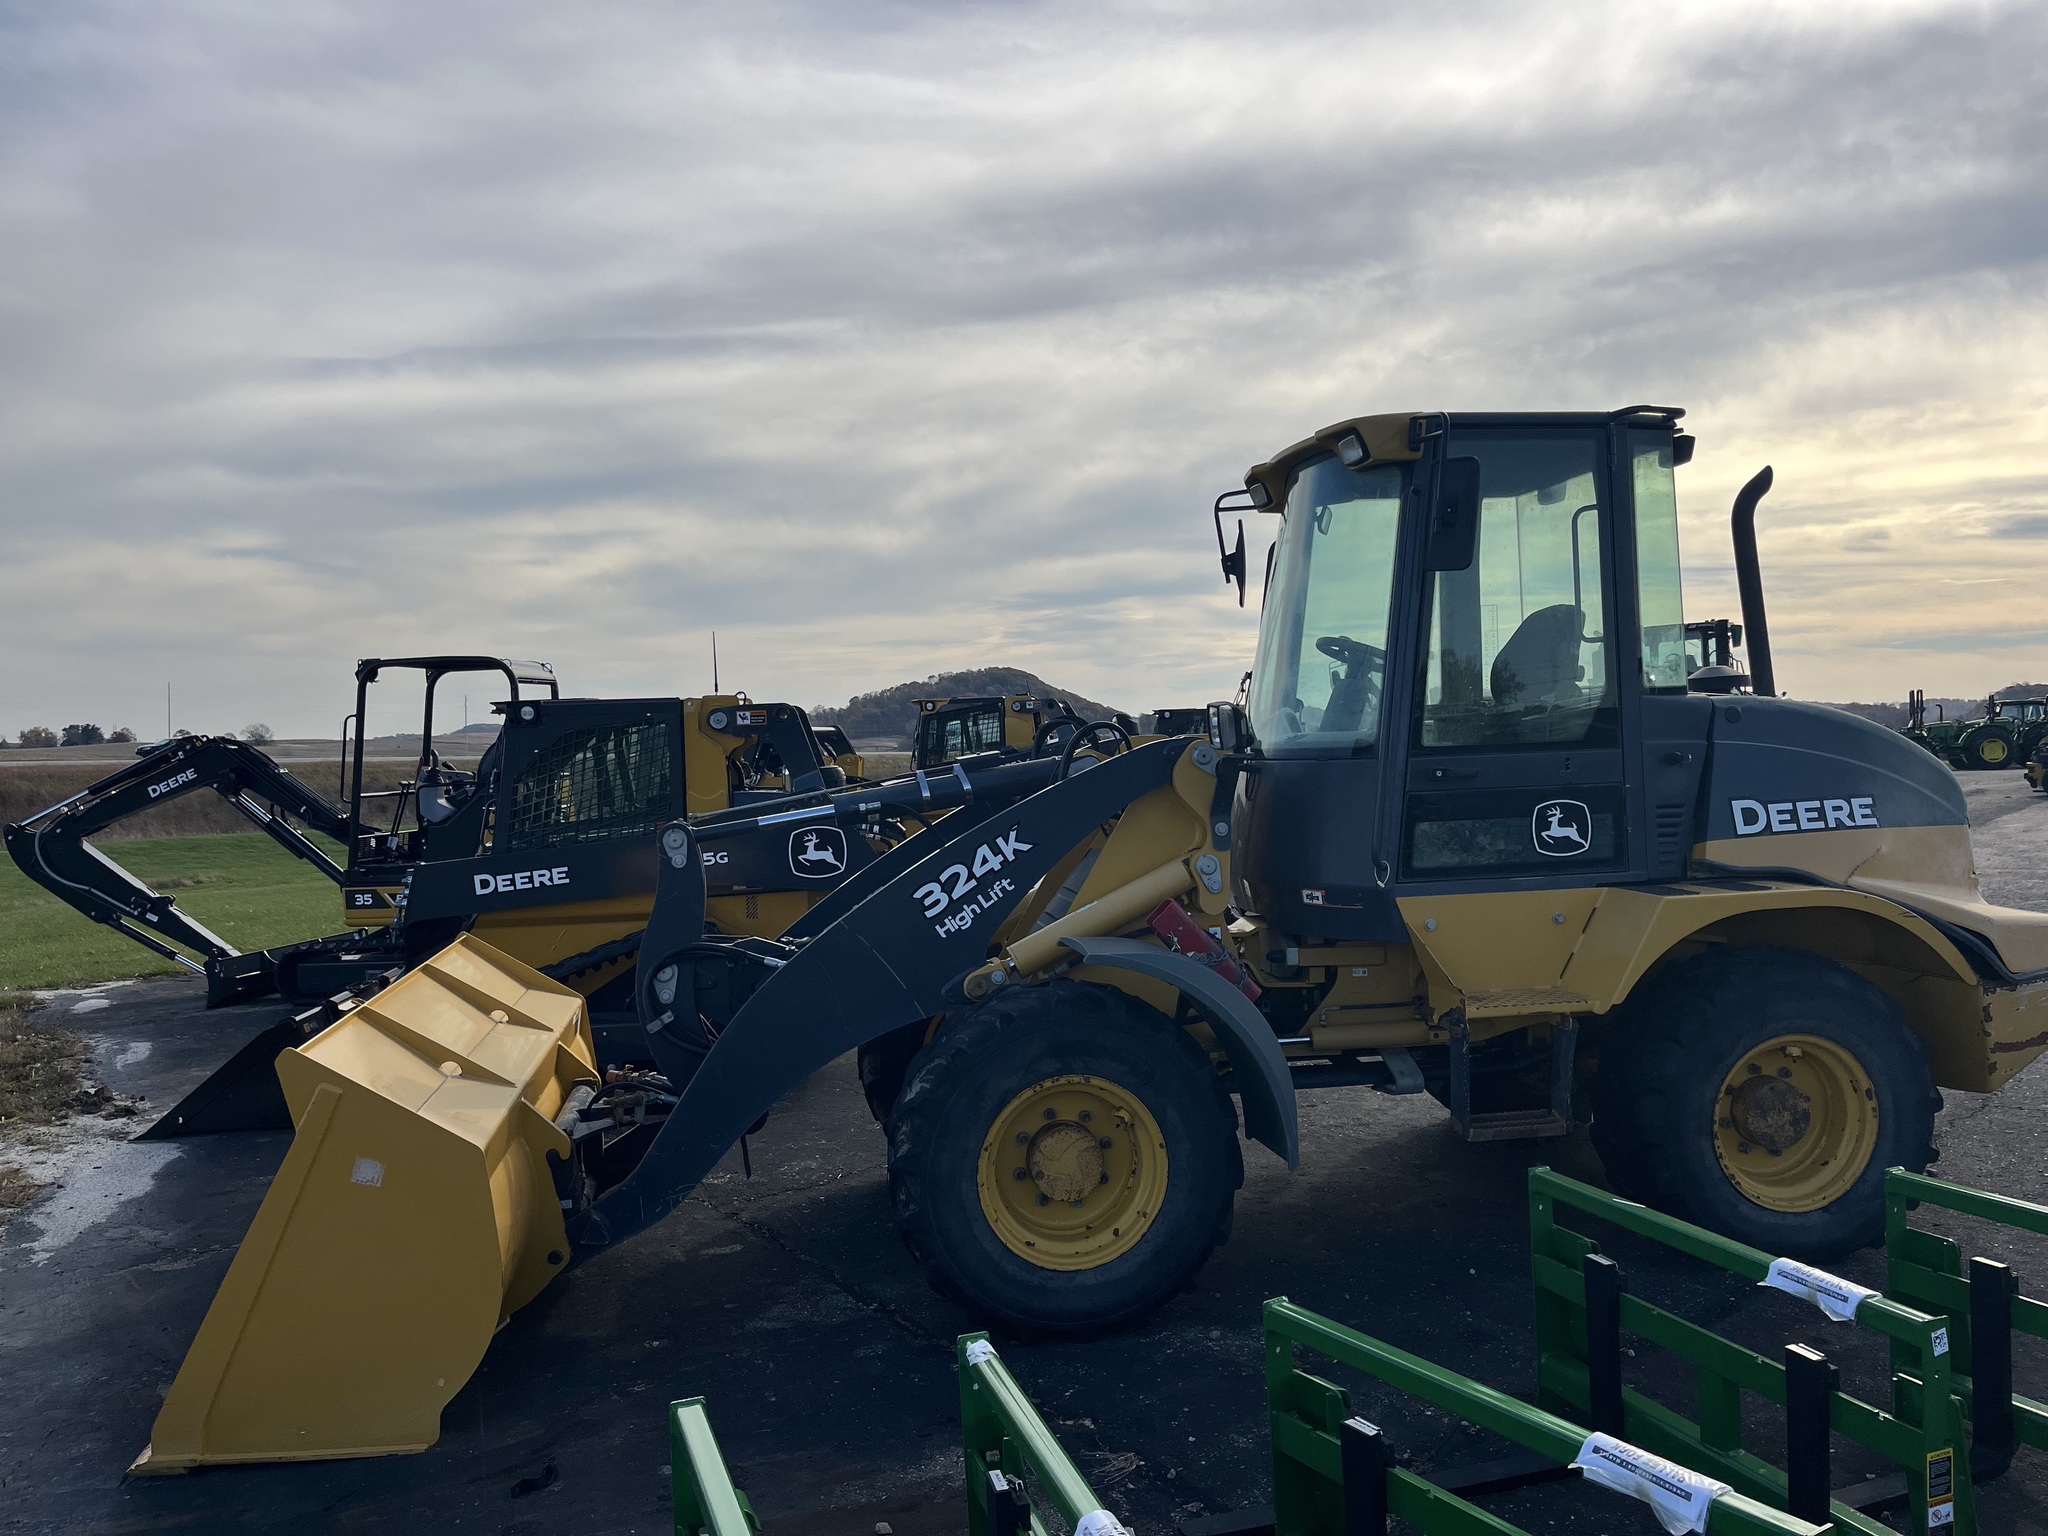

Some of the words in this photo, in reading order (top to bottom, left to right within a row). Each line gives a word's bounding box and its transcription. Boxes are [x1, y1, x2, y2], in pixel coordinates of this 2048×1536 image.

[147, 768, 198, 798] DEERE
[1731, 797, 1880, 836] DEERE
[473, 866, 570, 895] DEERE
[912, 824, 1034, 918] 324K
[354, 893, 373, 906] 35
[934, 904, 982, 938] High
[976, 878, 1016, 909] Lift
[1611, 1442, 1644, 1461] FORK
